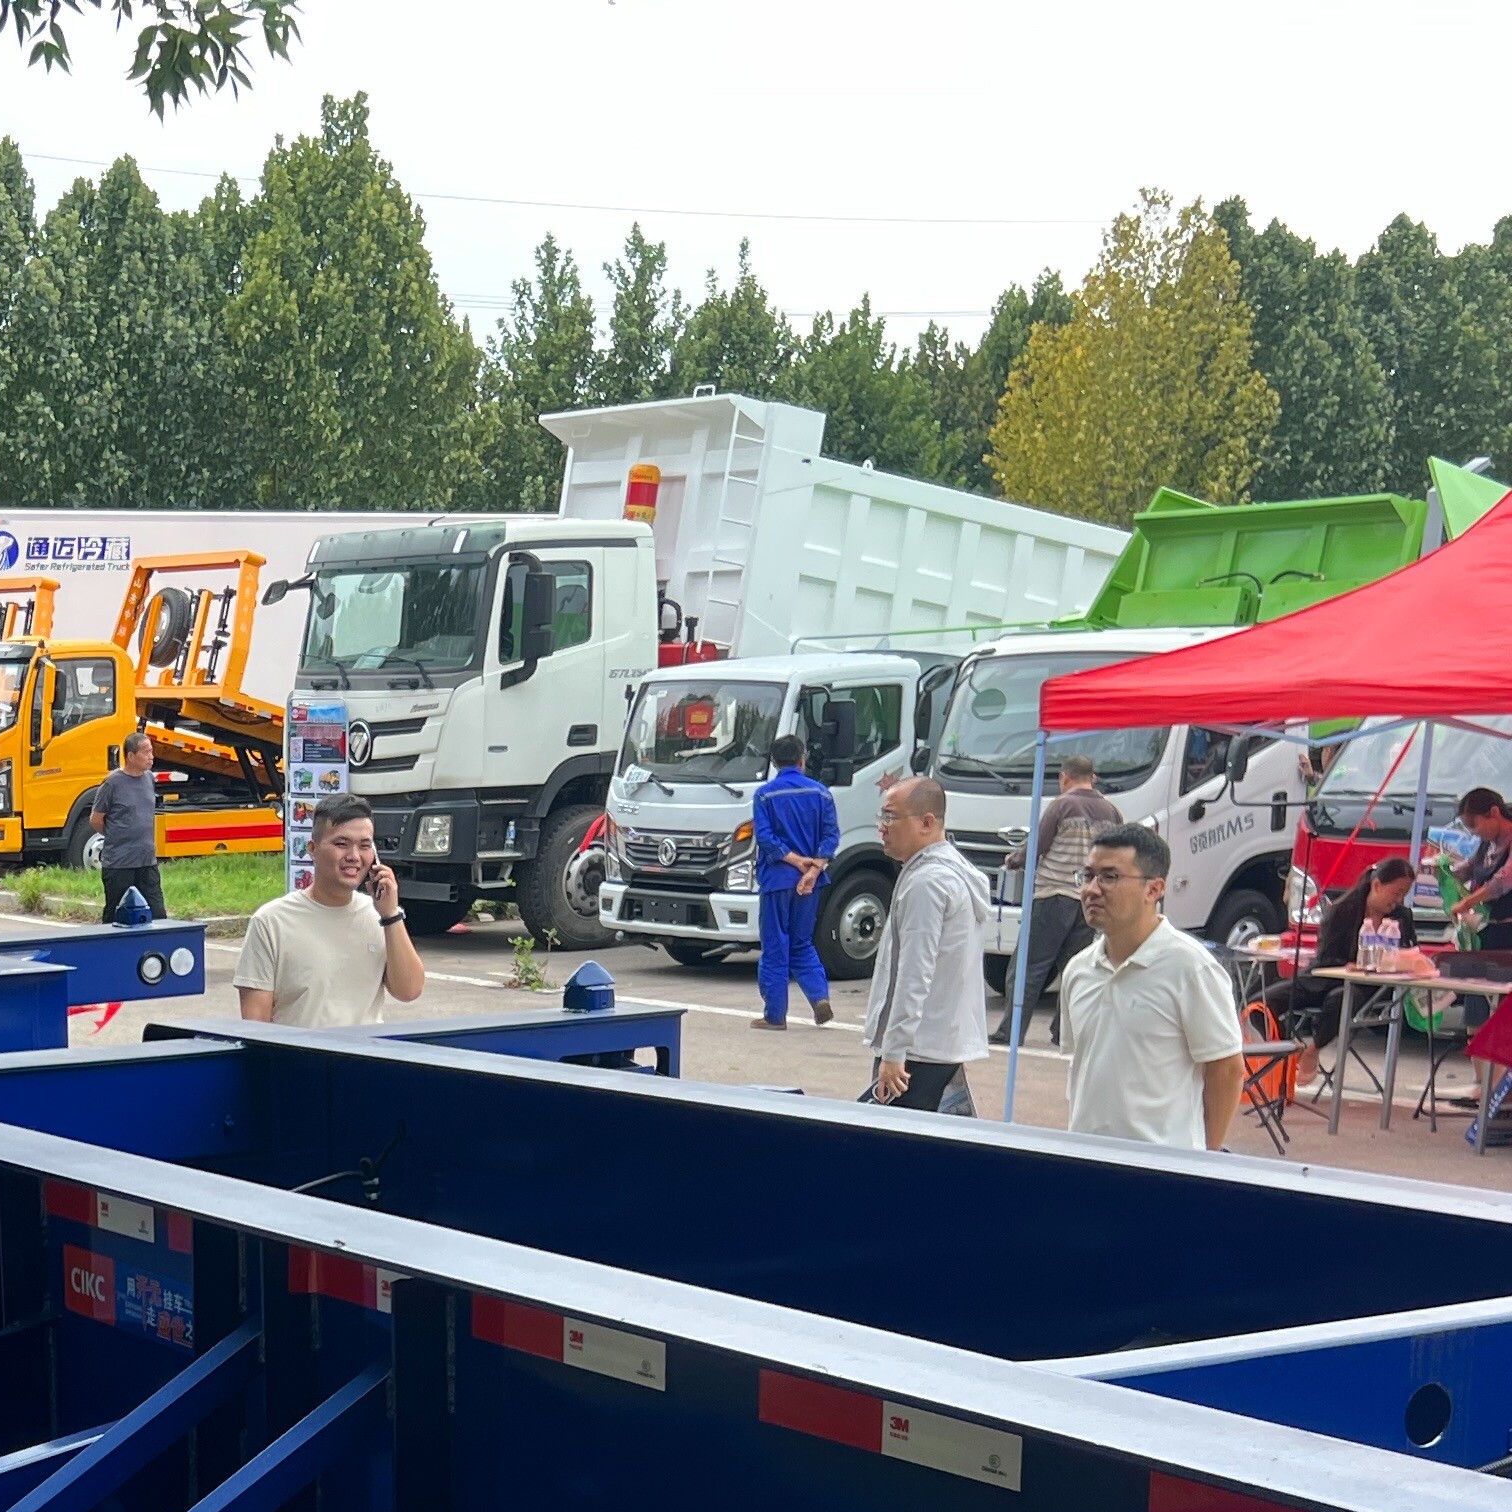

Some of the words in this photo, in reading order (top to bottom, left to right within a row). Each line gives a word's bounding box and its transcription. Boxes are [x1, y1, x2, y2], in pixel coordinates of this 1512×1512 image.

[26, 536, 130, 560] 通迈冷藏
[106, 562, 130, 571] Truck
[70, 1267, 106, 1302] CIKC
[569, 1329, 584, 1345] 3M
[889, 1416, 910, 1434] 3M
